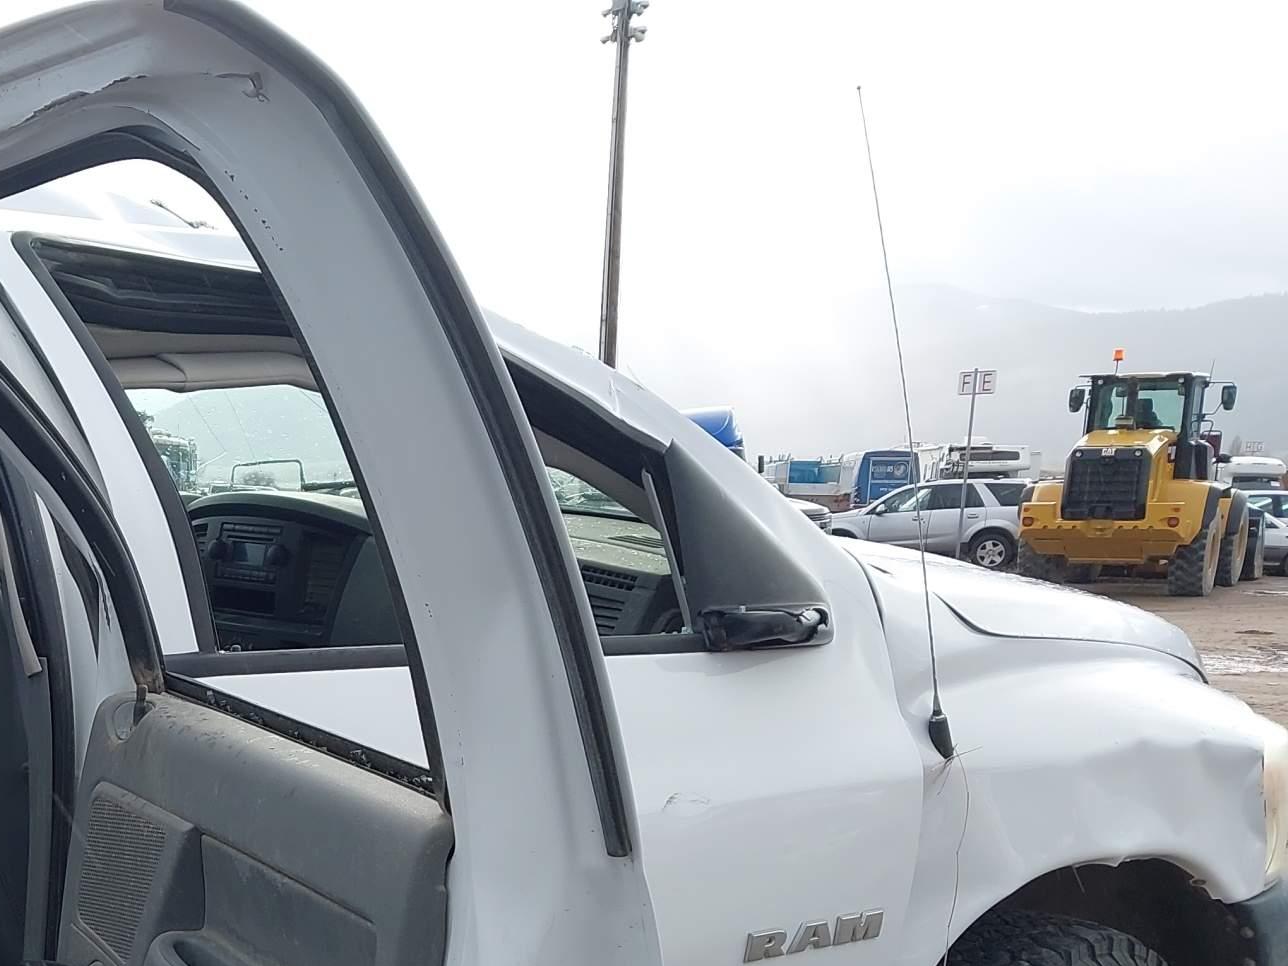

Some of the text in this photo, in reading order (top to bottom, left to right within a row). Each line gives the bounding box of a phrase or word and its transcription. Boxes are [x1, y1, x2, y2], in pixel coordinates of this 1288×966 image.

[962, 373, 993, 393] F E
[1102, 447, 1117, 456] CAT
[743, 909, 885, 963] RAM
